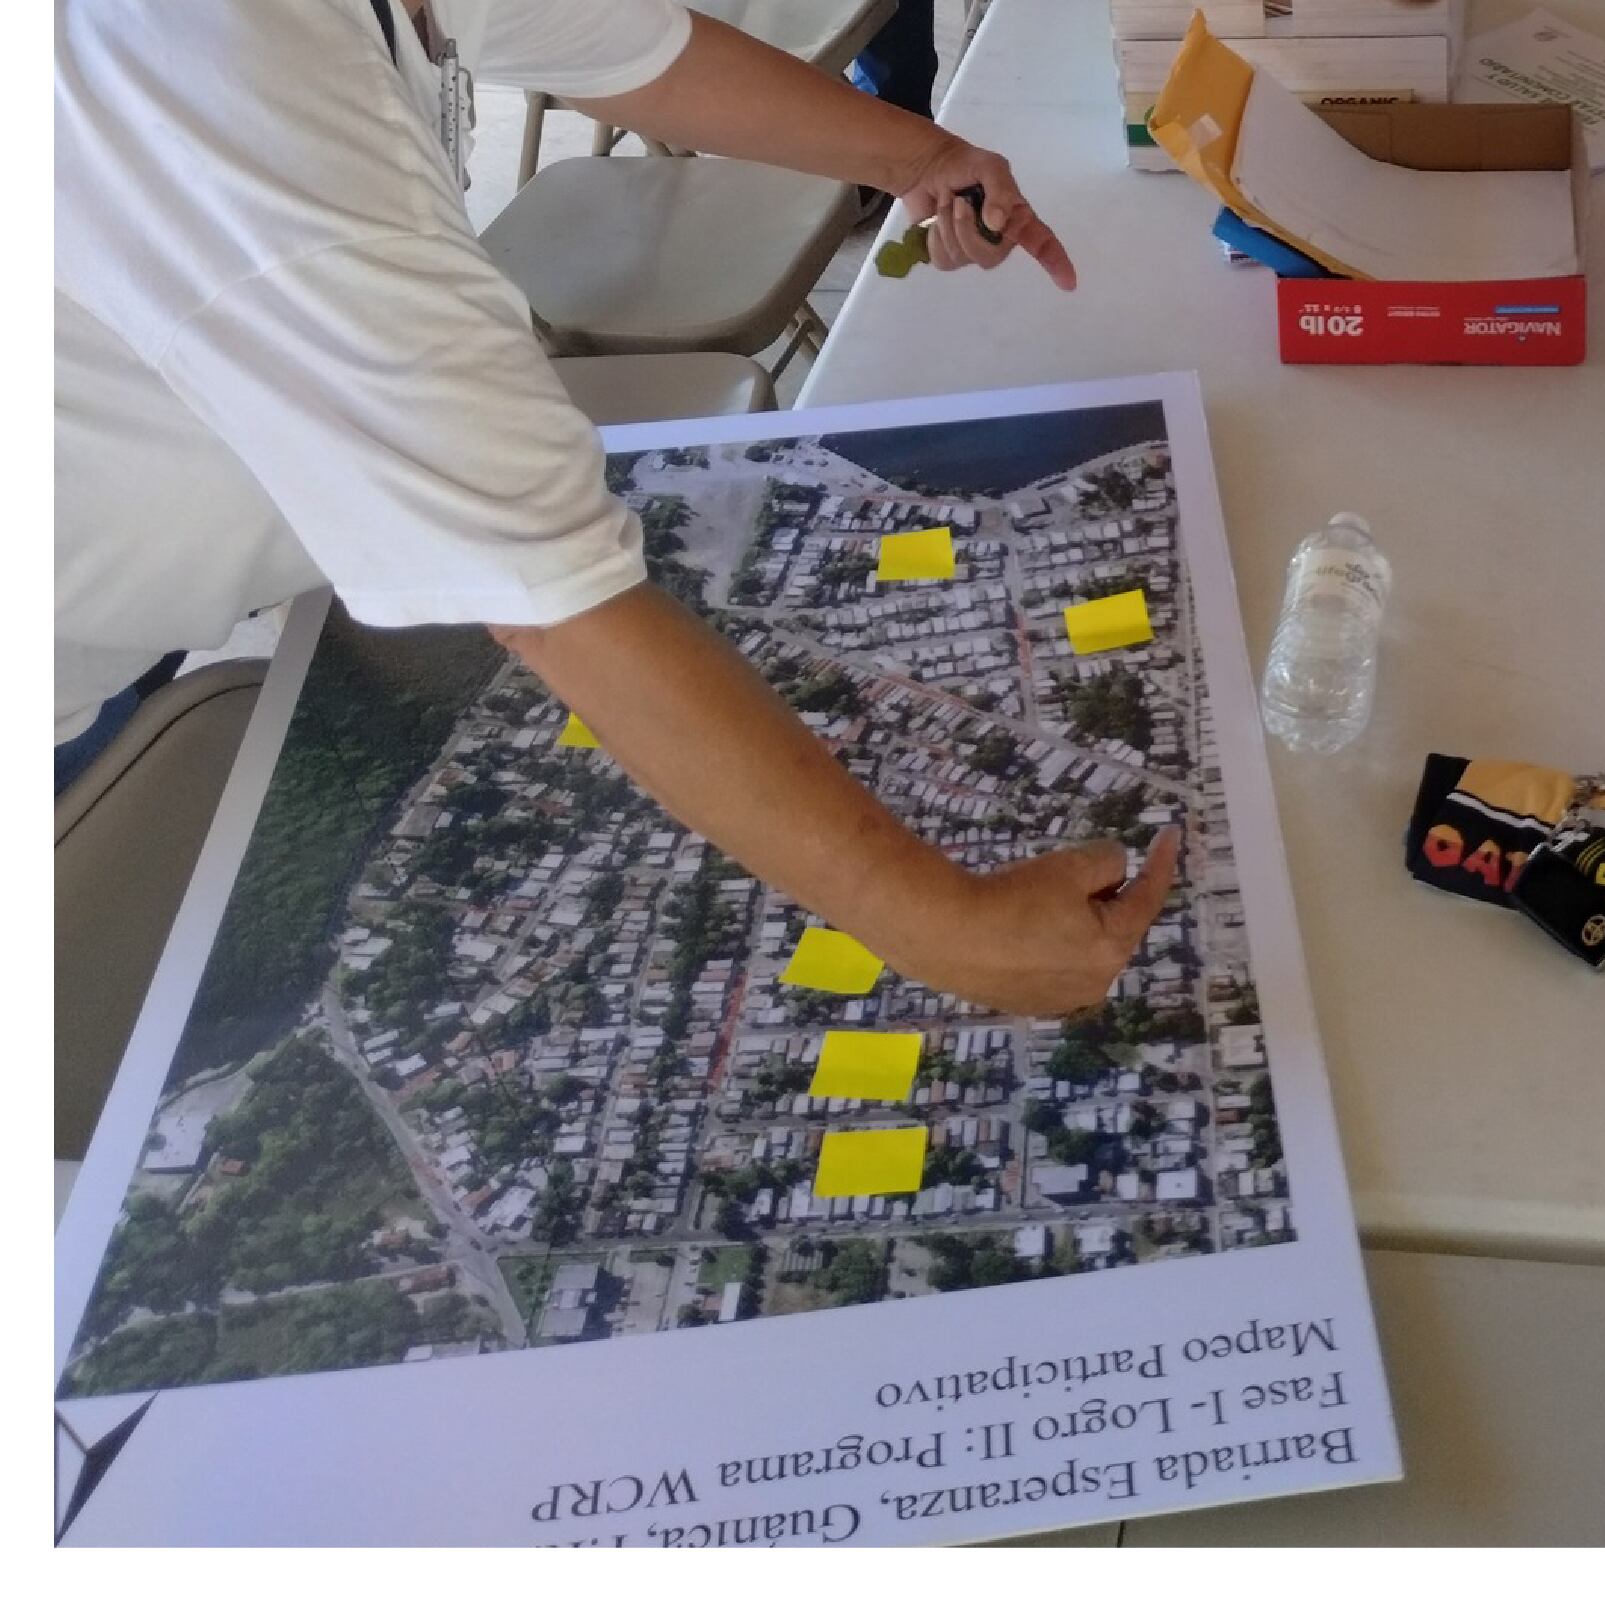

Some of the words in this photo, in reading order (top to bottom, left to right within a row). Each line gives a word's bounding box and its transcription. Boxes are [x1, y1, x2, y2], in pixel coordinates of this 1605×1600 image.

[1183, 1317, 1340, 1362] Mapeo
[875, 1344, 1169, 1412] Participativo
[1241, 1371, 1350, 1409] Fase
[965, 1420, 1017, 1461] II:
[1032, 1397, 1175, 1441] Logro
[717, 1432, 947, 1488] Programa
[1155, 1426, 1360, 1489] Barriada
[531, 1468, 700, 1522] WCRP
[879, 1459, 1141, 1521] Esperanza,
